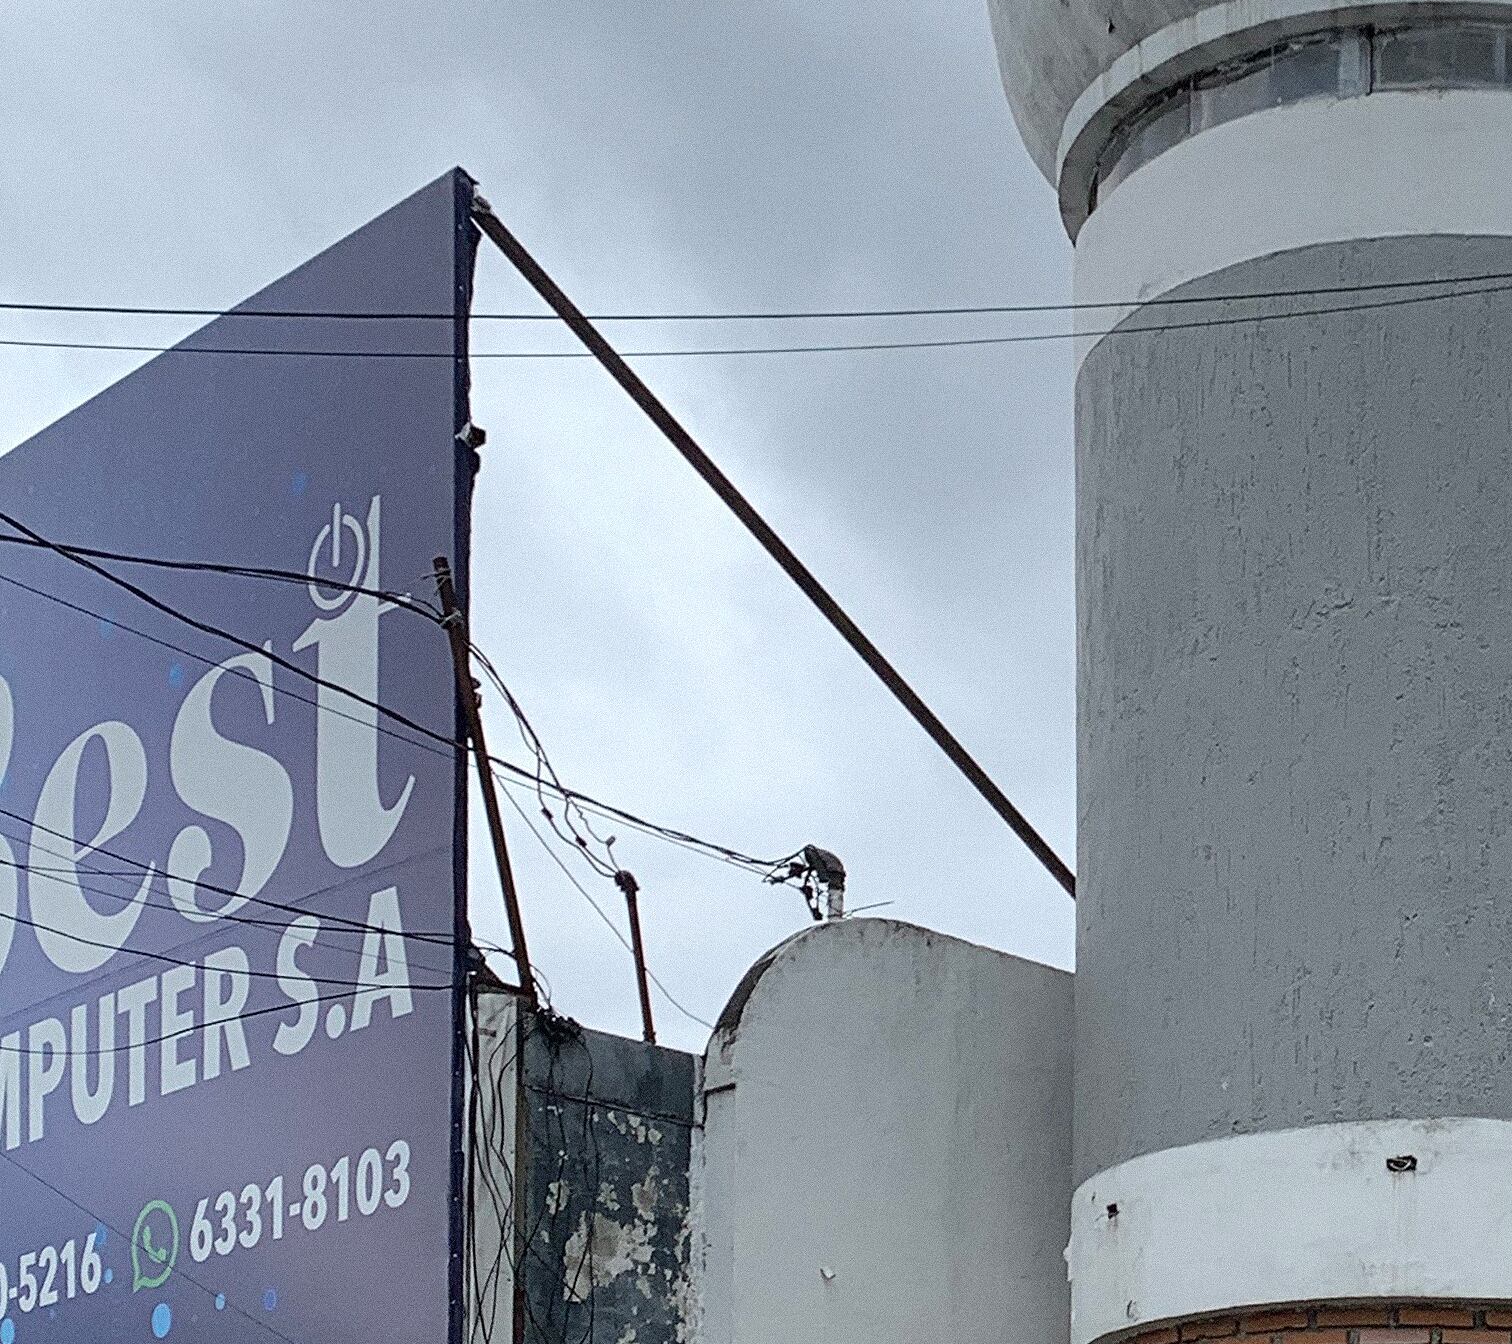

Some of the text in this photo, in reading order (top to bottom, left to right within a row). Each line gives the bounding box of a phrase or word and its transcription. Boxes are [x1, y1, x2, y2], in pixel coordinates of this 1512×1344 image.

[0, 495, 415, 976] est
[273, 886, 413, 1056] S.A
[190, 1140, 411, 1262] 6331-8103
